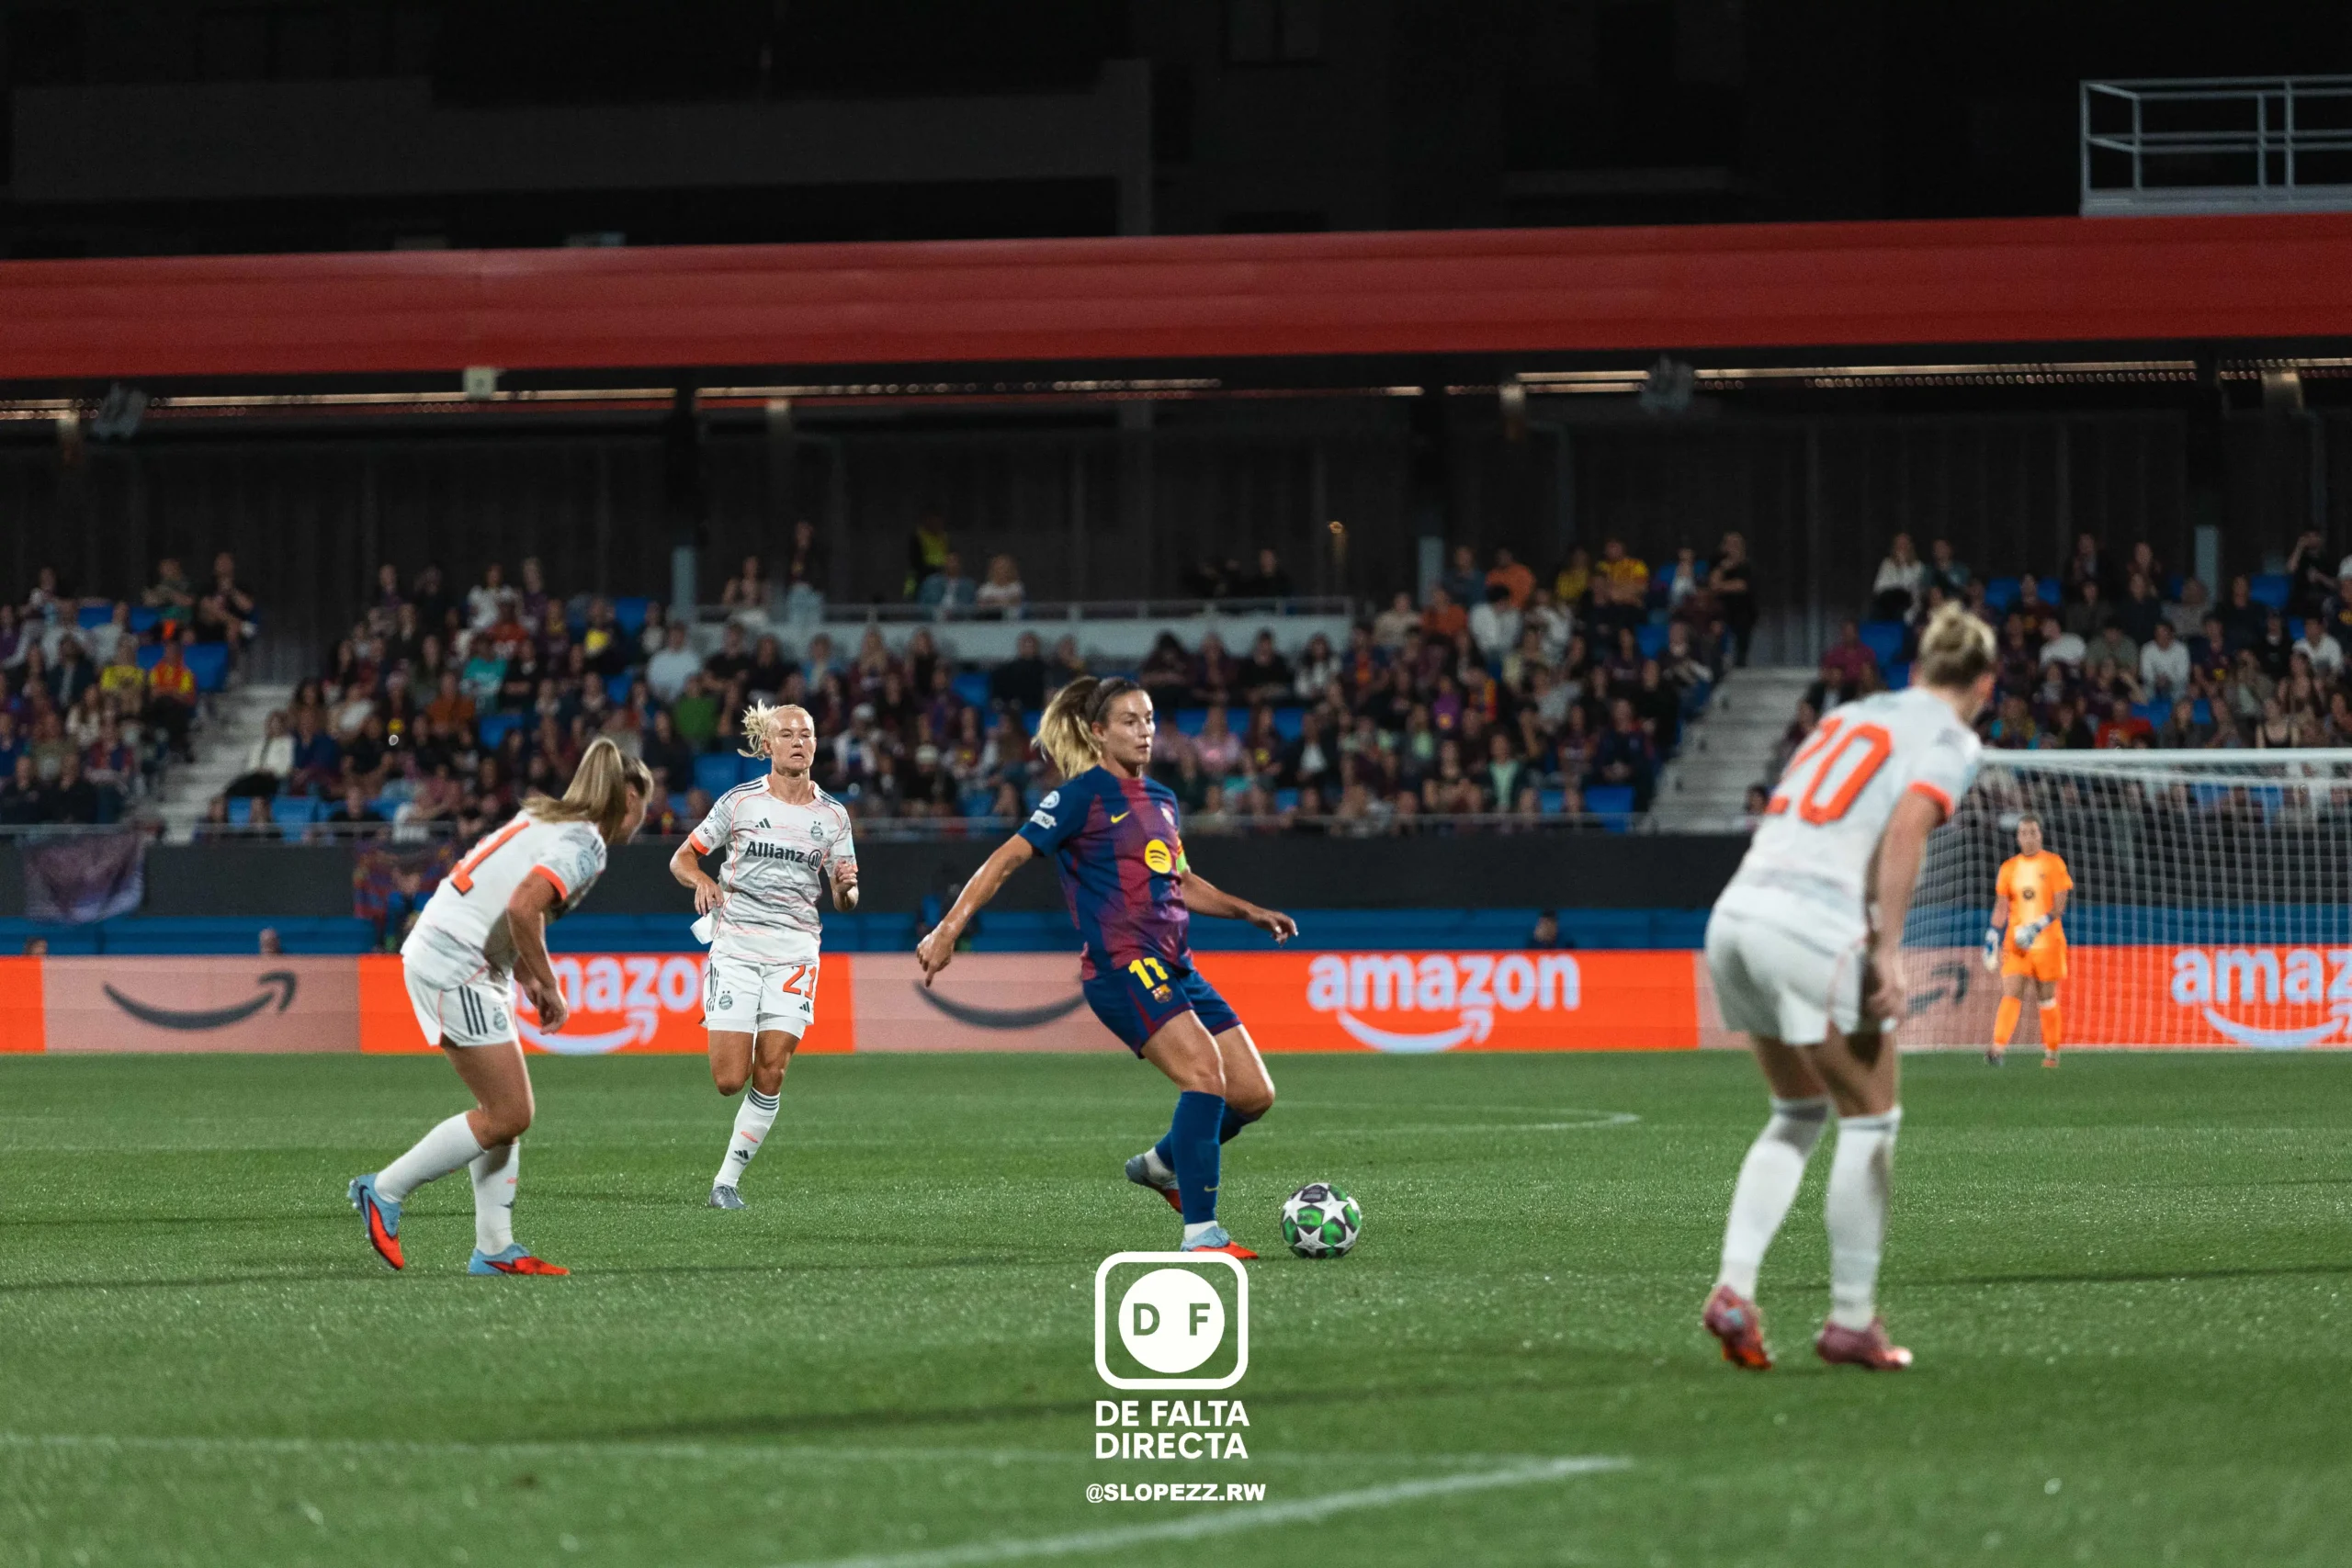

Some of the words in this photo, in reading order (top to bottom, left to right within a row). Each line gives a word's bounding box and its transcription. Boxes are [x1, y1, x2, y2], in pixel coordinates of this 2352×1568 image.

[1764, 716, 1894, 826] 20
[448, 820, 530, 897] 1
[745, 840, 806, 863] Allianz
[782, 964, 817, 1000] 21
[1128, 957, 1169, 989] 11
[1306, 953, 1581, 1011] amazon
